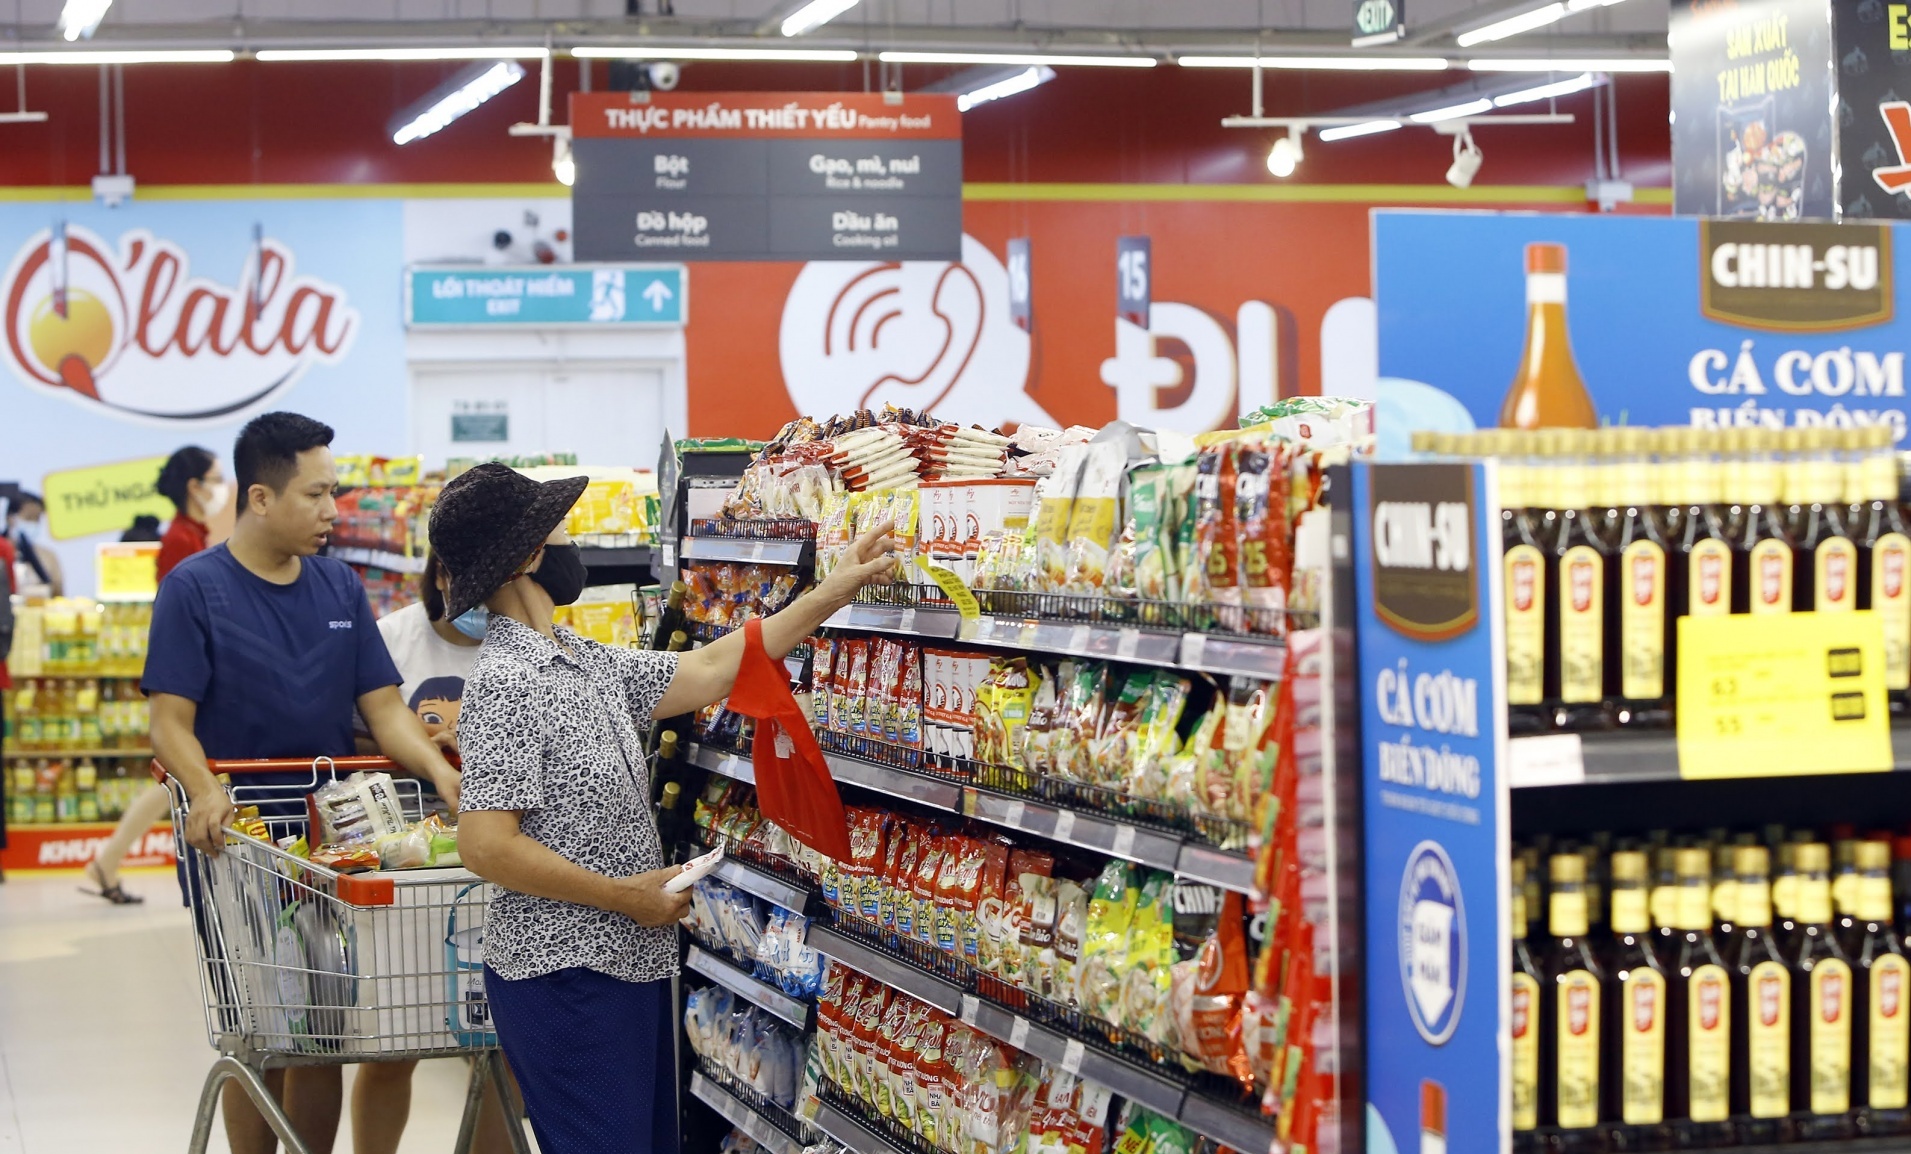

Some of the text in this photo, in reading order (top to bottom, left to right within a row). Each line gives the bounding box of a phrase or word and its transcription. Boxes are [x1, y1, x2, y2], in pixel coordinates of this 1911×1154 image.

[1753, 9, 1788, 55] XUẤT
[1717, 67, 1740, 106] TẠI
[1766, 48, 1800, 92] QUỐC
[605, 101, 931, 133] THỰC PHẨM THIẾT YẾU Pantry food
[654, 154, 689, 177] Bột
[809, 154, 921, 176] Gạo, mì, nui
[655, 176, 687, 189] Flour
[825, 176, 904, 189] Rice & noodle
[636, 210, 708, 235] Đồ hộp
[832, 211, 899, 231] Dầu ăn
[634, 233, 710, 247] Canned food
[832, 234, 899, 249] Cooking oil
[1119, 250, 1146, 301] 15
[1711, 242, 1878, 290] CHIN-SU
[432, 276, 465, 299] LỐI
[1688, 338, 1906, 397] CÁ CƠM
[1374, 500, 1470, 572] CHIN-SU
[1377, 656, 1479, 738] CÁ CƠM
